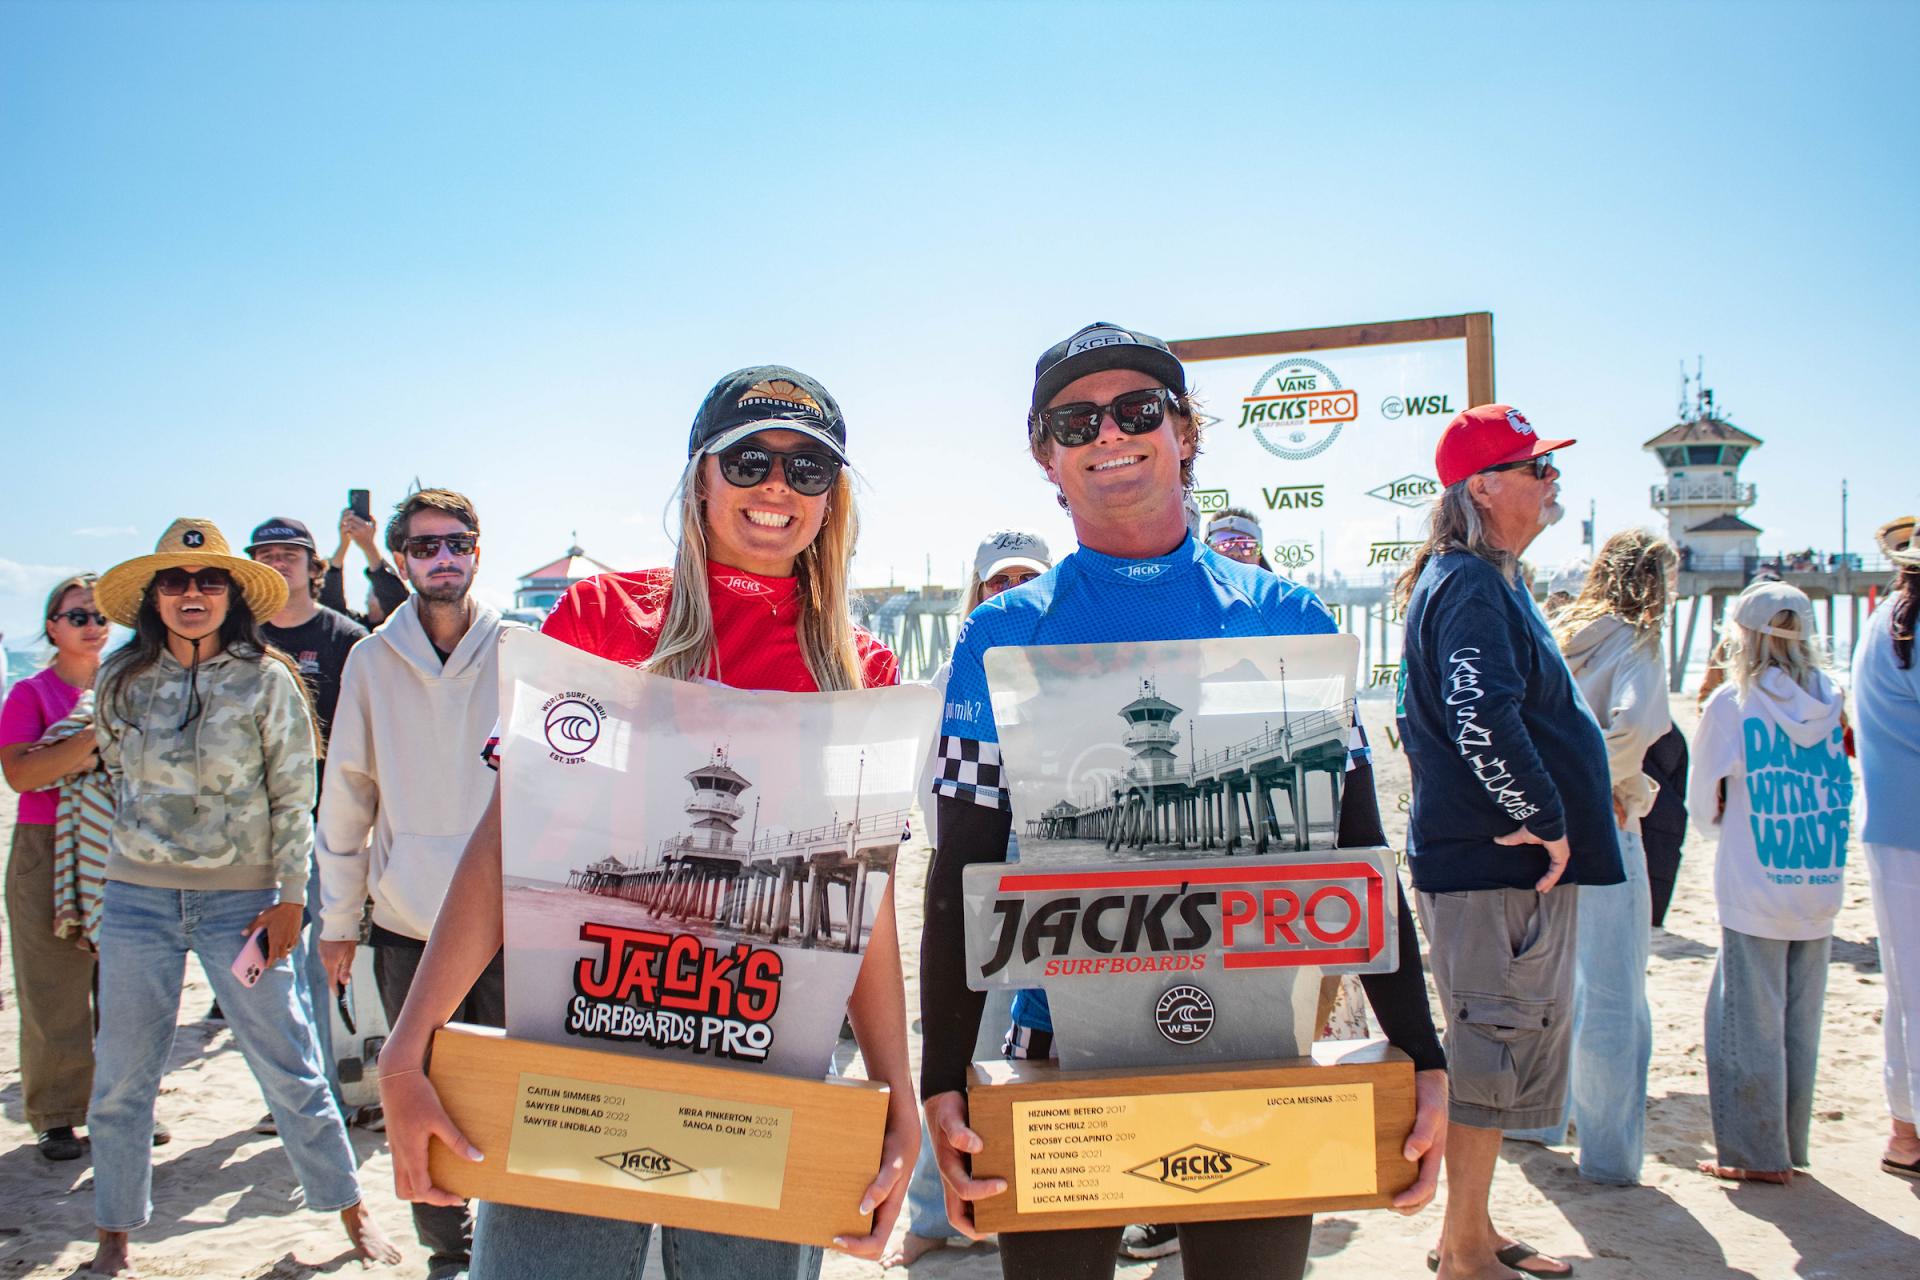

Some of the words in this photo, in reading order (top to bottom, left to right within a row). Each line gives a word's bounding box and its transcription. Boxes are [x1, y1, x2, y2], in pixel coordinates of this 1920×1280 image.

[1276, 375, 1316, 392] VANS
[1308, 397, 1351, 417] PRO
[1405, 395, 1455, 416] WSL
[1262, 484, 1325, 510] VANS
[1274, 544, 1314, 563] 805
[1446, 647, 1485, 706] CABO
[541, 693, 565, 712] WORLD
[566, 691, 587, 699] SURF
[586, 696, 608, 720] LEAGUE
[1456, 706, 1493, 756] SAN
[566, 757, 586, 765] 1976
[1746, 770, 1819, 815] WITH
[980, 881, 1218, 978] JACK'S
[1221, 886, 1363, 947] PRO
[578, 923, 782, 1022] JACK'S
[1044, 954, 1206, 978] SURFBOARDS
[571, 995, 696, 1044] SURFBOARDS
[699, 1016, 772, 1058] PRO
[1167, 1023, 1204, 1033] WSL
[527, 1086, 560, 1097] CAITLIN
[563, 1090, 601, 1103] SIMMERS
[603, 1095, 626, 1106] 2021
[1267, 1097, 1296, 1106] LUCCA
[1297, 1095, 1333, 1104] MESINAS
[525, 1100, 560, 1112] SAWYER
[561, 1105, 604, 1118] LINDBLAD
[605, 1111, 630, 1122] 2022
[679, 1107, 703, 1118] KIRRA
[705, 1110, 753, 1123] PINKERTON
[755, 1116, 778, 1126] 2024
[1028, 1107, 1071, 1117] HIZUNOME
[1106, 1105, 1127, 1114] 2017
[523, 1115, 558, 1128] SAWYER
[559, 1122, 602, 1134] LINDBLAD
[603, 1126, 628, 1138] 2023
[683, 1119, 713, 1131] SANOA
[748, 1128, 773, 1139] 2025
[1028, 1123, 1052, 1132] KEVIN
[1054, 1121, 1085, 1130] SCHULZ
[1029, 1136, 1062, 1146] CROSBY
[1064, 1134, 1113, 1144] COLAPINTO
[1115, 1133, 1136, 1142] 2019
[1030, 1152, 1046, 1160] NAT
[1048, 1151, 1079, 1160] YOUNG
[1081, 1150, 1103, 1159] 2021
[1031, 1167, 1058, 1175] KEANU
[1060, 1166, 1086, 1175] ASING
[1088, 1165, 1111, 1173] 2022
[1032, 1181, 1056, 1190] JOHN
[1058, 1180, 1074, 1188] MEL
[1033, 1196, 1062, 1204] LUCCA
[1063, 1193, 1099, 1202] MESINAS
[1102, 1192, 1124, 1200] 2024
